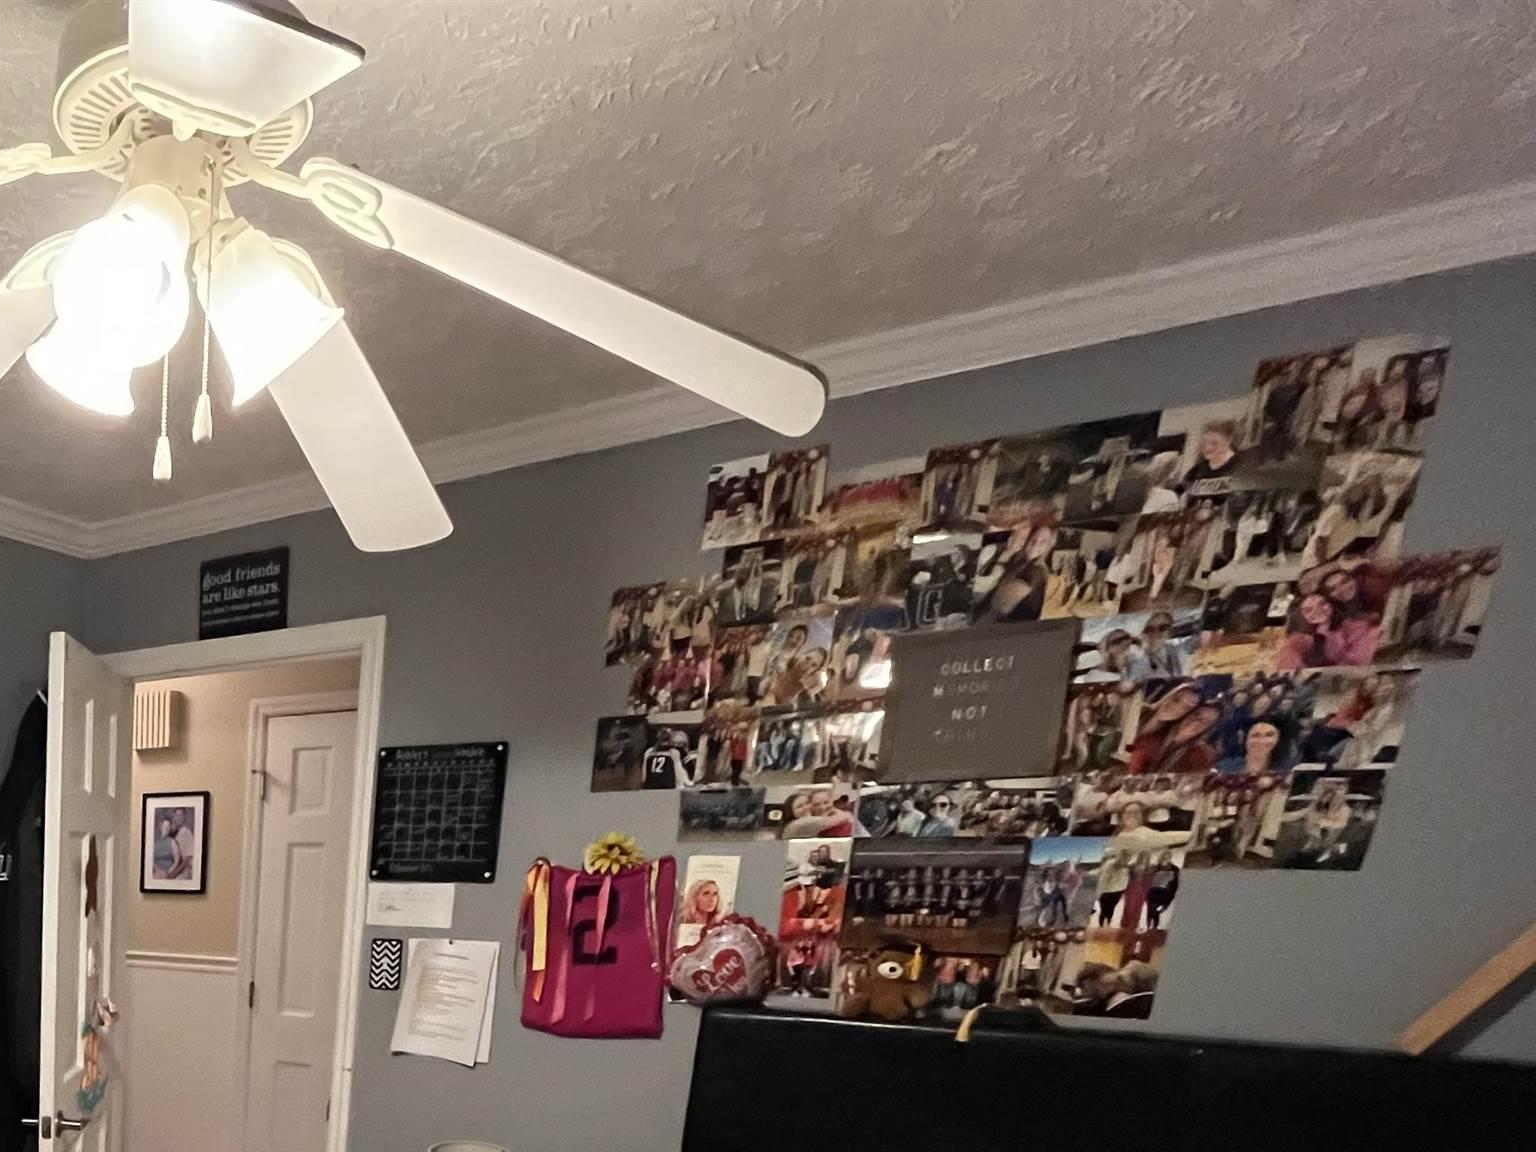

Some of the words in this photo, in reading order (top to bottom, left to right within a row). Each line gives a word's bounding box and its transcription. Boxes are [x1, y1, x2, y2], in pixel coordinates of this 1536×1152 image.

[202, 567, 231, 591] good
[235, 560, 281, 582] friends
[202, 592, 221, 605] are
[223, 586, 245, 601] like
[941, 655, 1015, 676] COLLECT
[951, 705, 988, 720] NOT
[651, 756, 666, 773] 12
[571, 885, 619, 965] 2
[696, 956, 742, 993] Love
